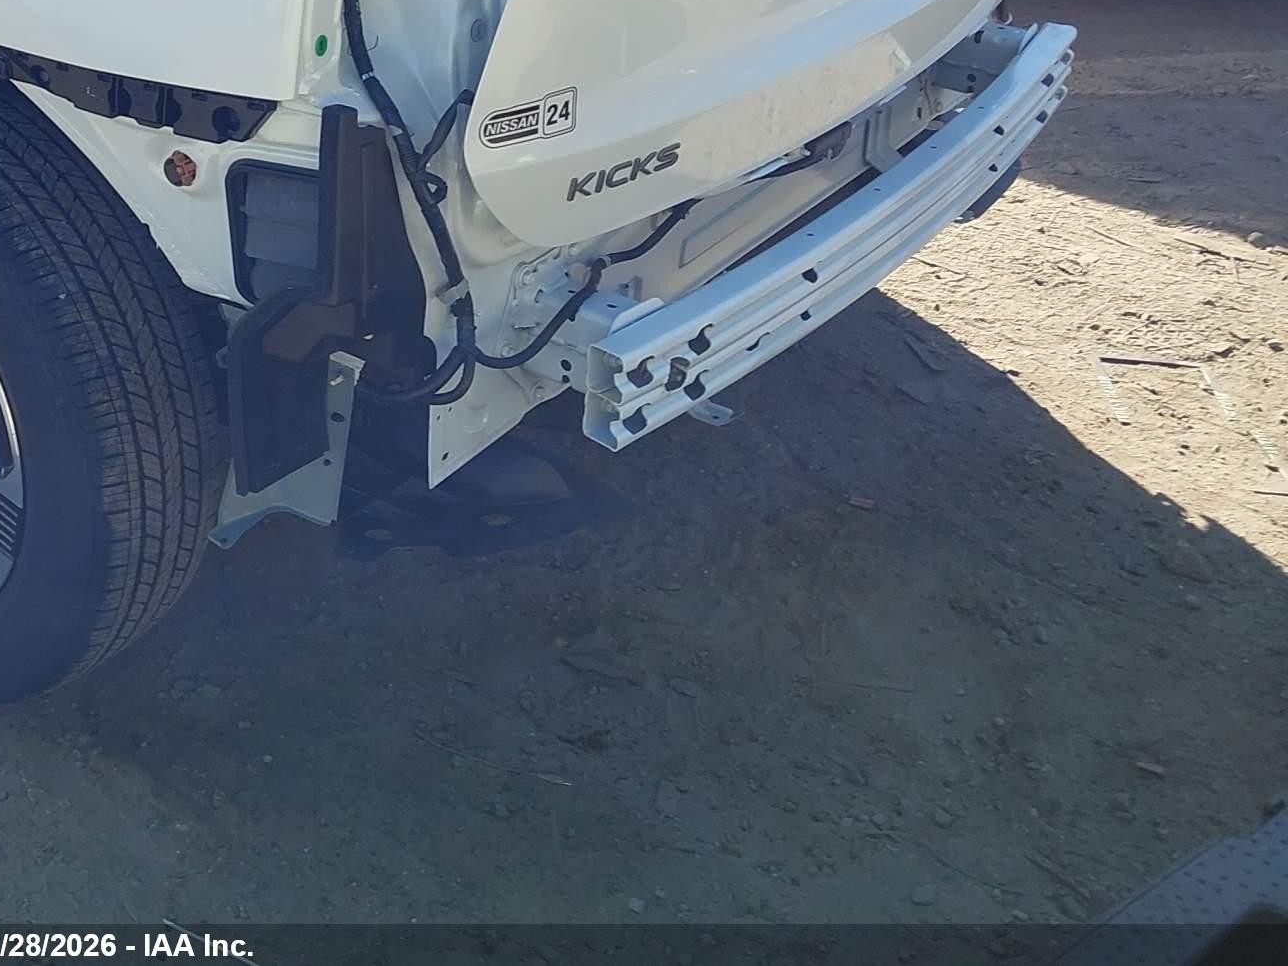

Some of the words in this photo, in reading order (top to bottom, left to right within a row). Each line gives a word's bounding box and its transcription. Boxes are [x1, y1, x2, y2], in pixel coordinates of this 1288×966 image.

[484, 112, 539, 137] NISSAN
[546, 100, 571, 126] 24
[566, 142, 681, 202] KICKS
